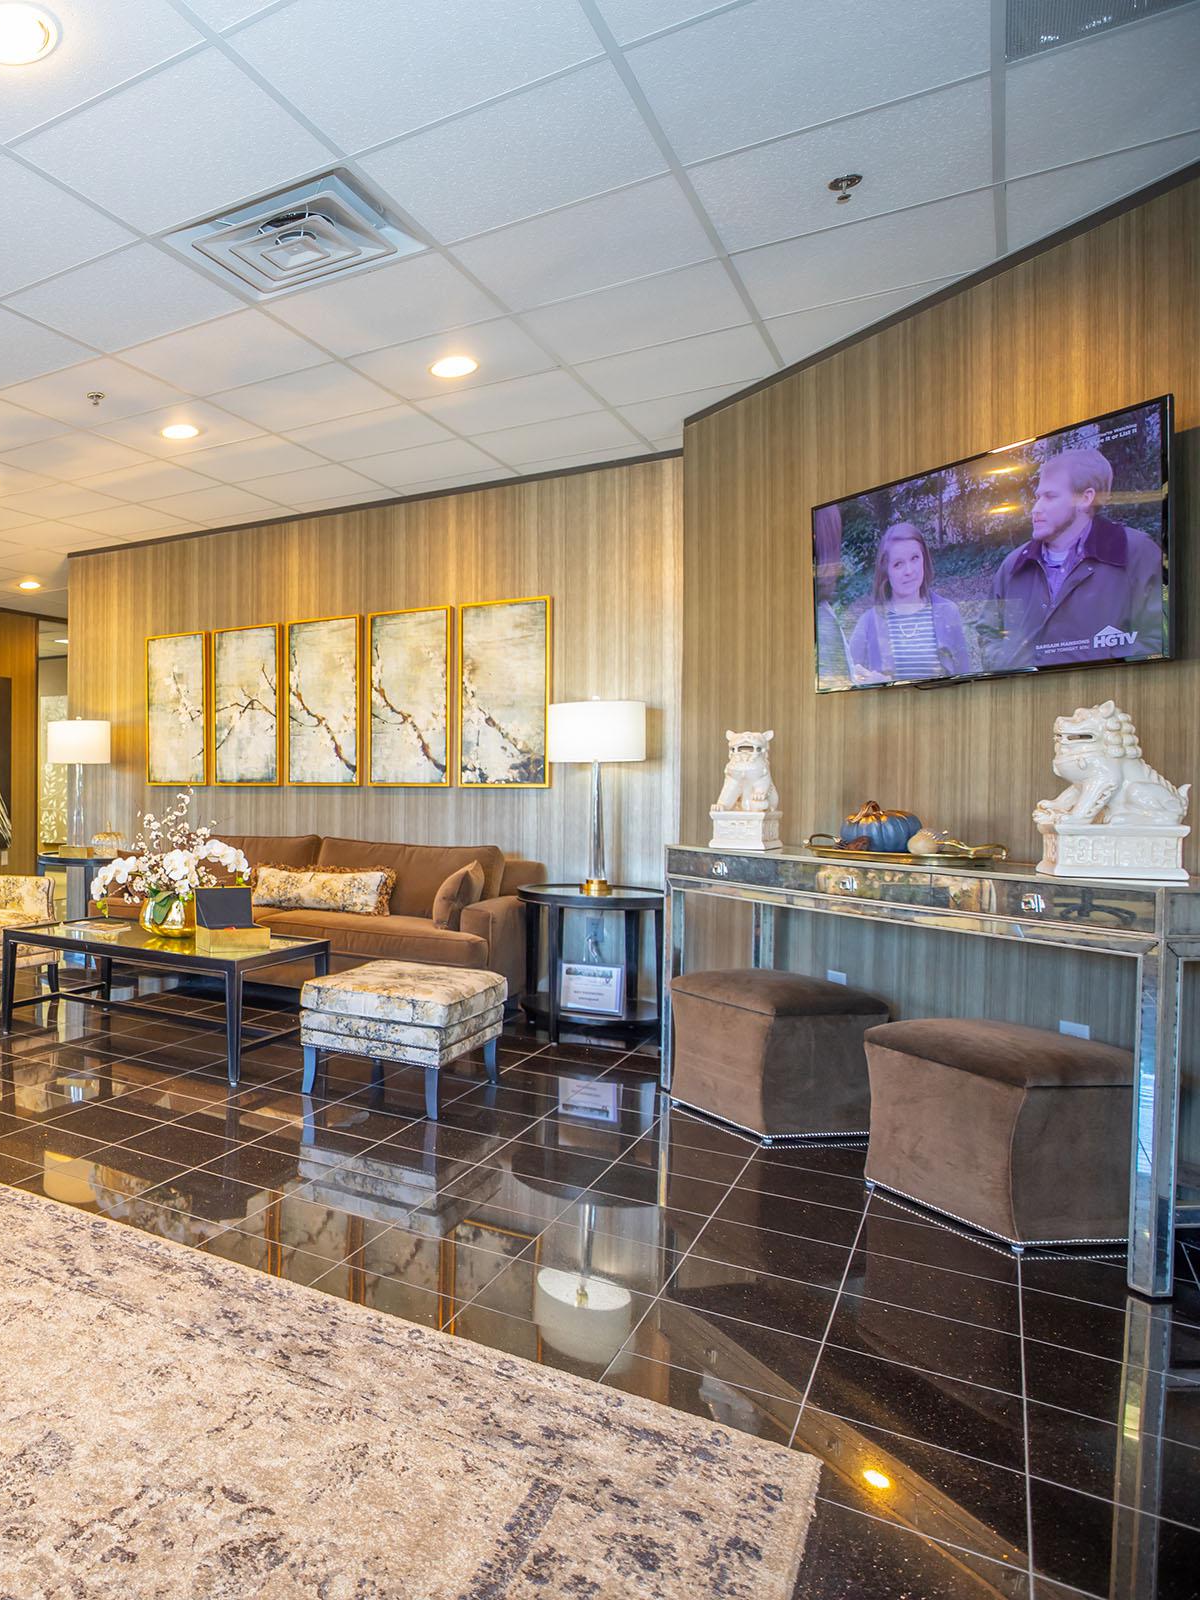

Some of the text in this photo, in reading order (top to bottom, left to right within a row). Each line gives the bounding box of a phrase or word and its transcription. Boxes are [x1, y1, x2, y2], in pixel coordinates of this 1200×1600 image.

[1035, 639, 1090, 650] BARGAIN MANSIONS
[1093, 631, 1138, 649] HGTV
